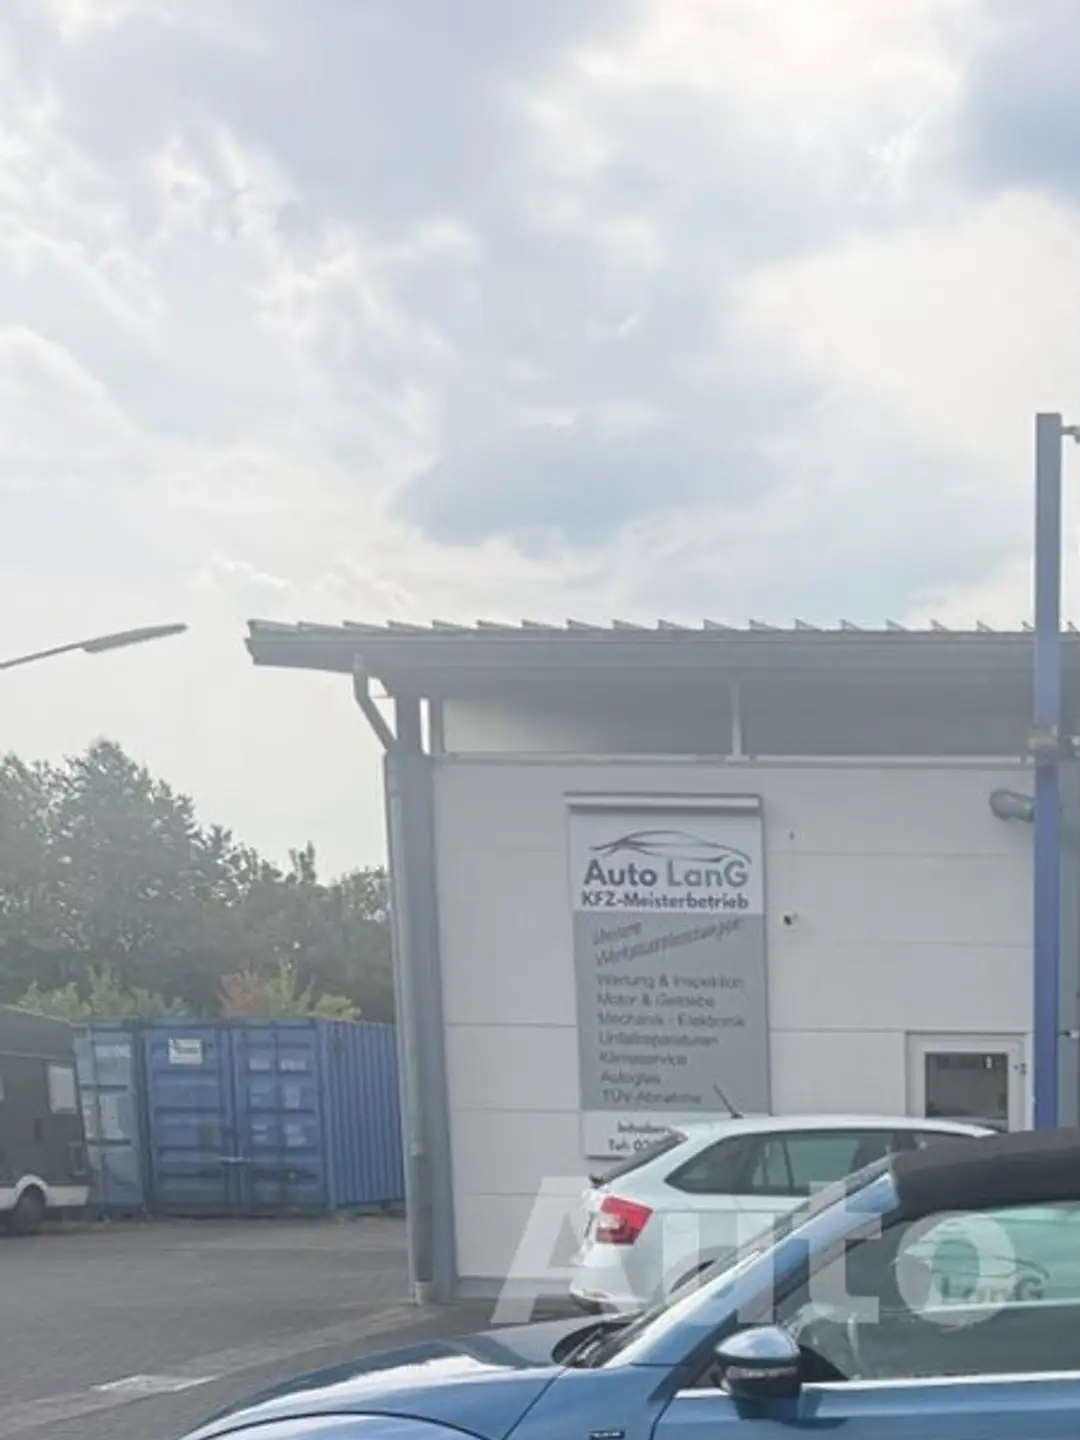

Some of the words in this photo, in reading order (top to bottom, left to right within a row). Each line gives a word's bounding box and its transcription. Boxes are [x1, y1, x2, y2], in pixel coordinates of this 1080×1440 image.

[583, 859, 658, 887] Auto
[667, 860, 748, 887] LanG
[581, 891, 750, 909] KFZ-Meisterbetrieb
